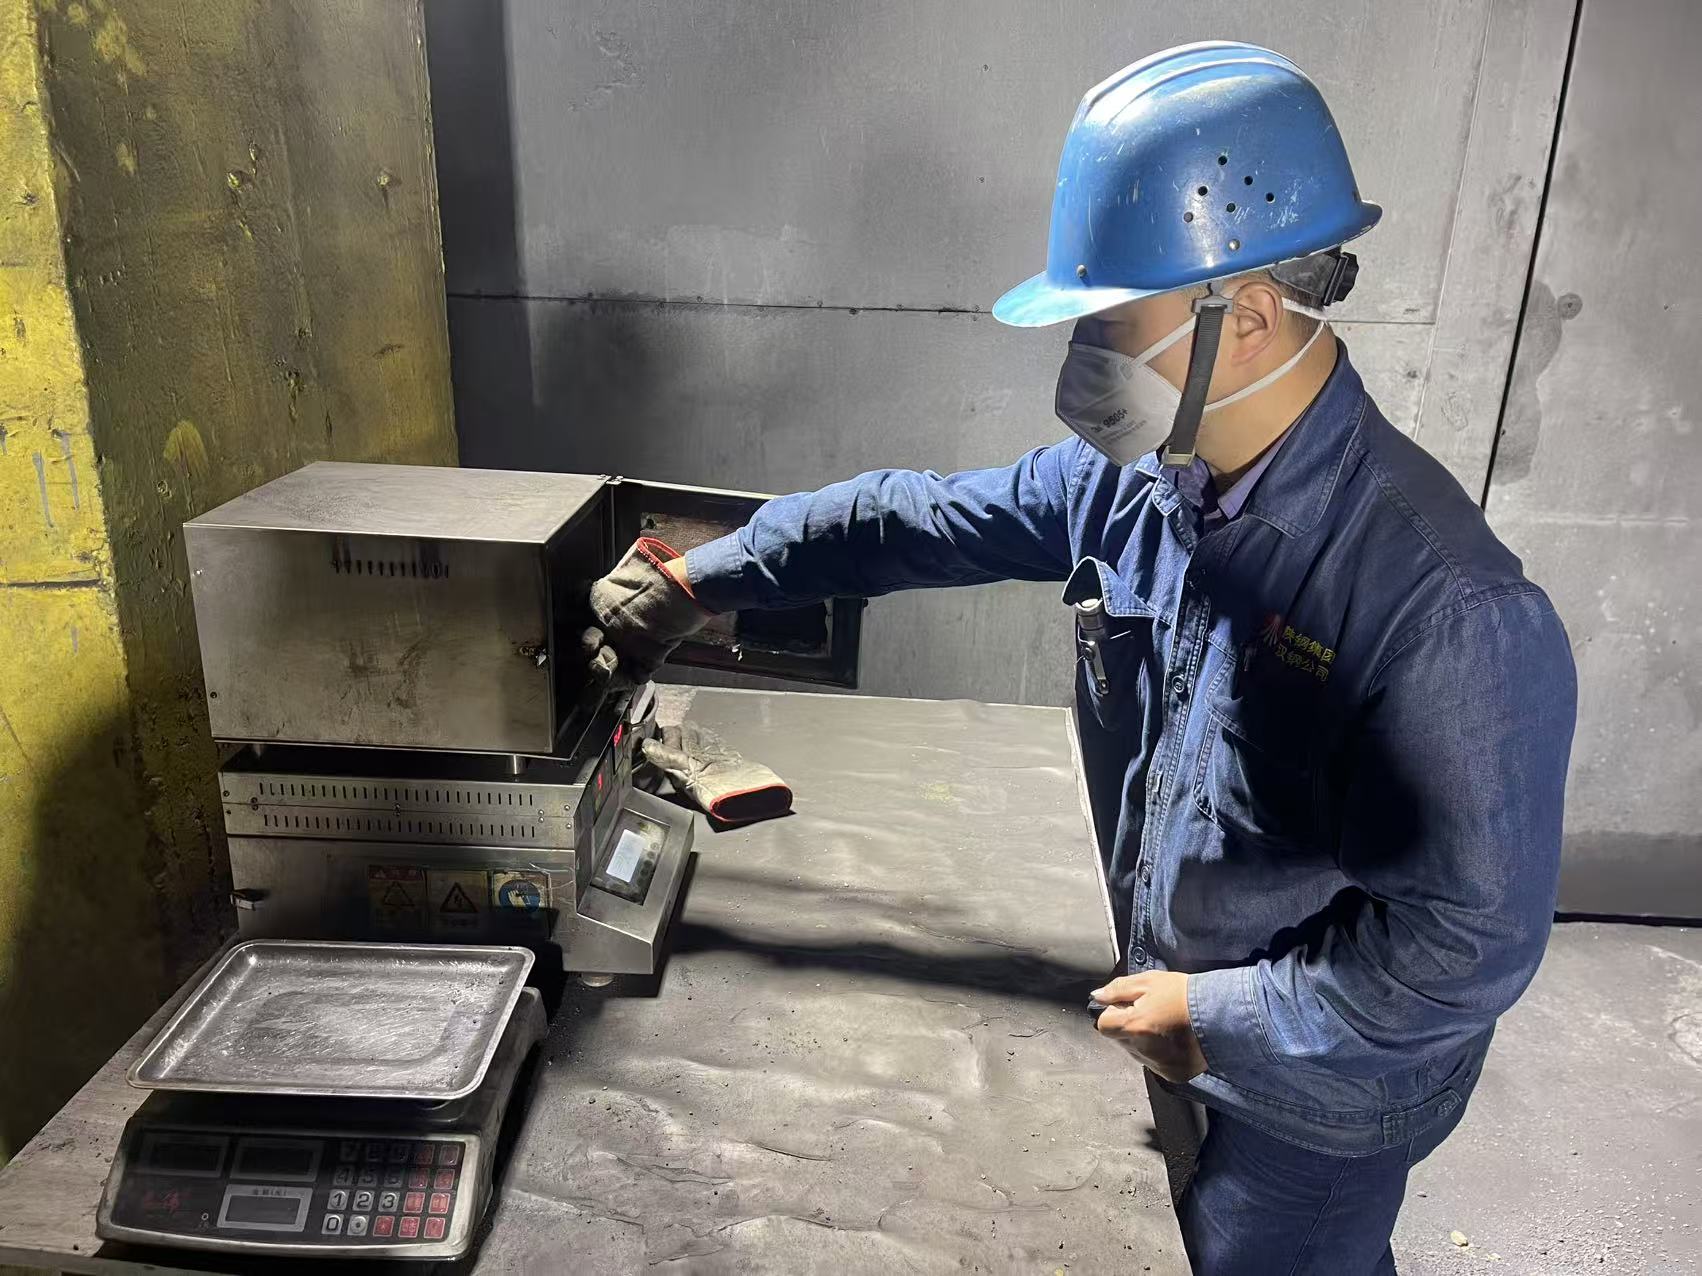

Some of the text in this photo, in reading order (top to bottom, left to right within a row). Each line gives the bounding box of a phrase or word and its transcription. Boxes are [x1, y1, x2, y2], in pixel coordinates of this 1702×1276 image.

[357, 1193, 369, 1208] 2
[382, 1194, 394, 1209] 3
[327, 1216, 339, 1231] 0
